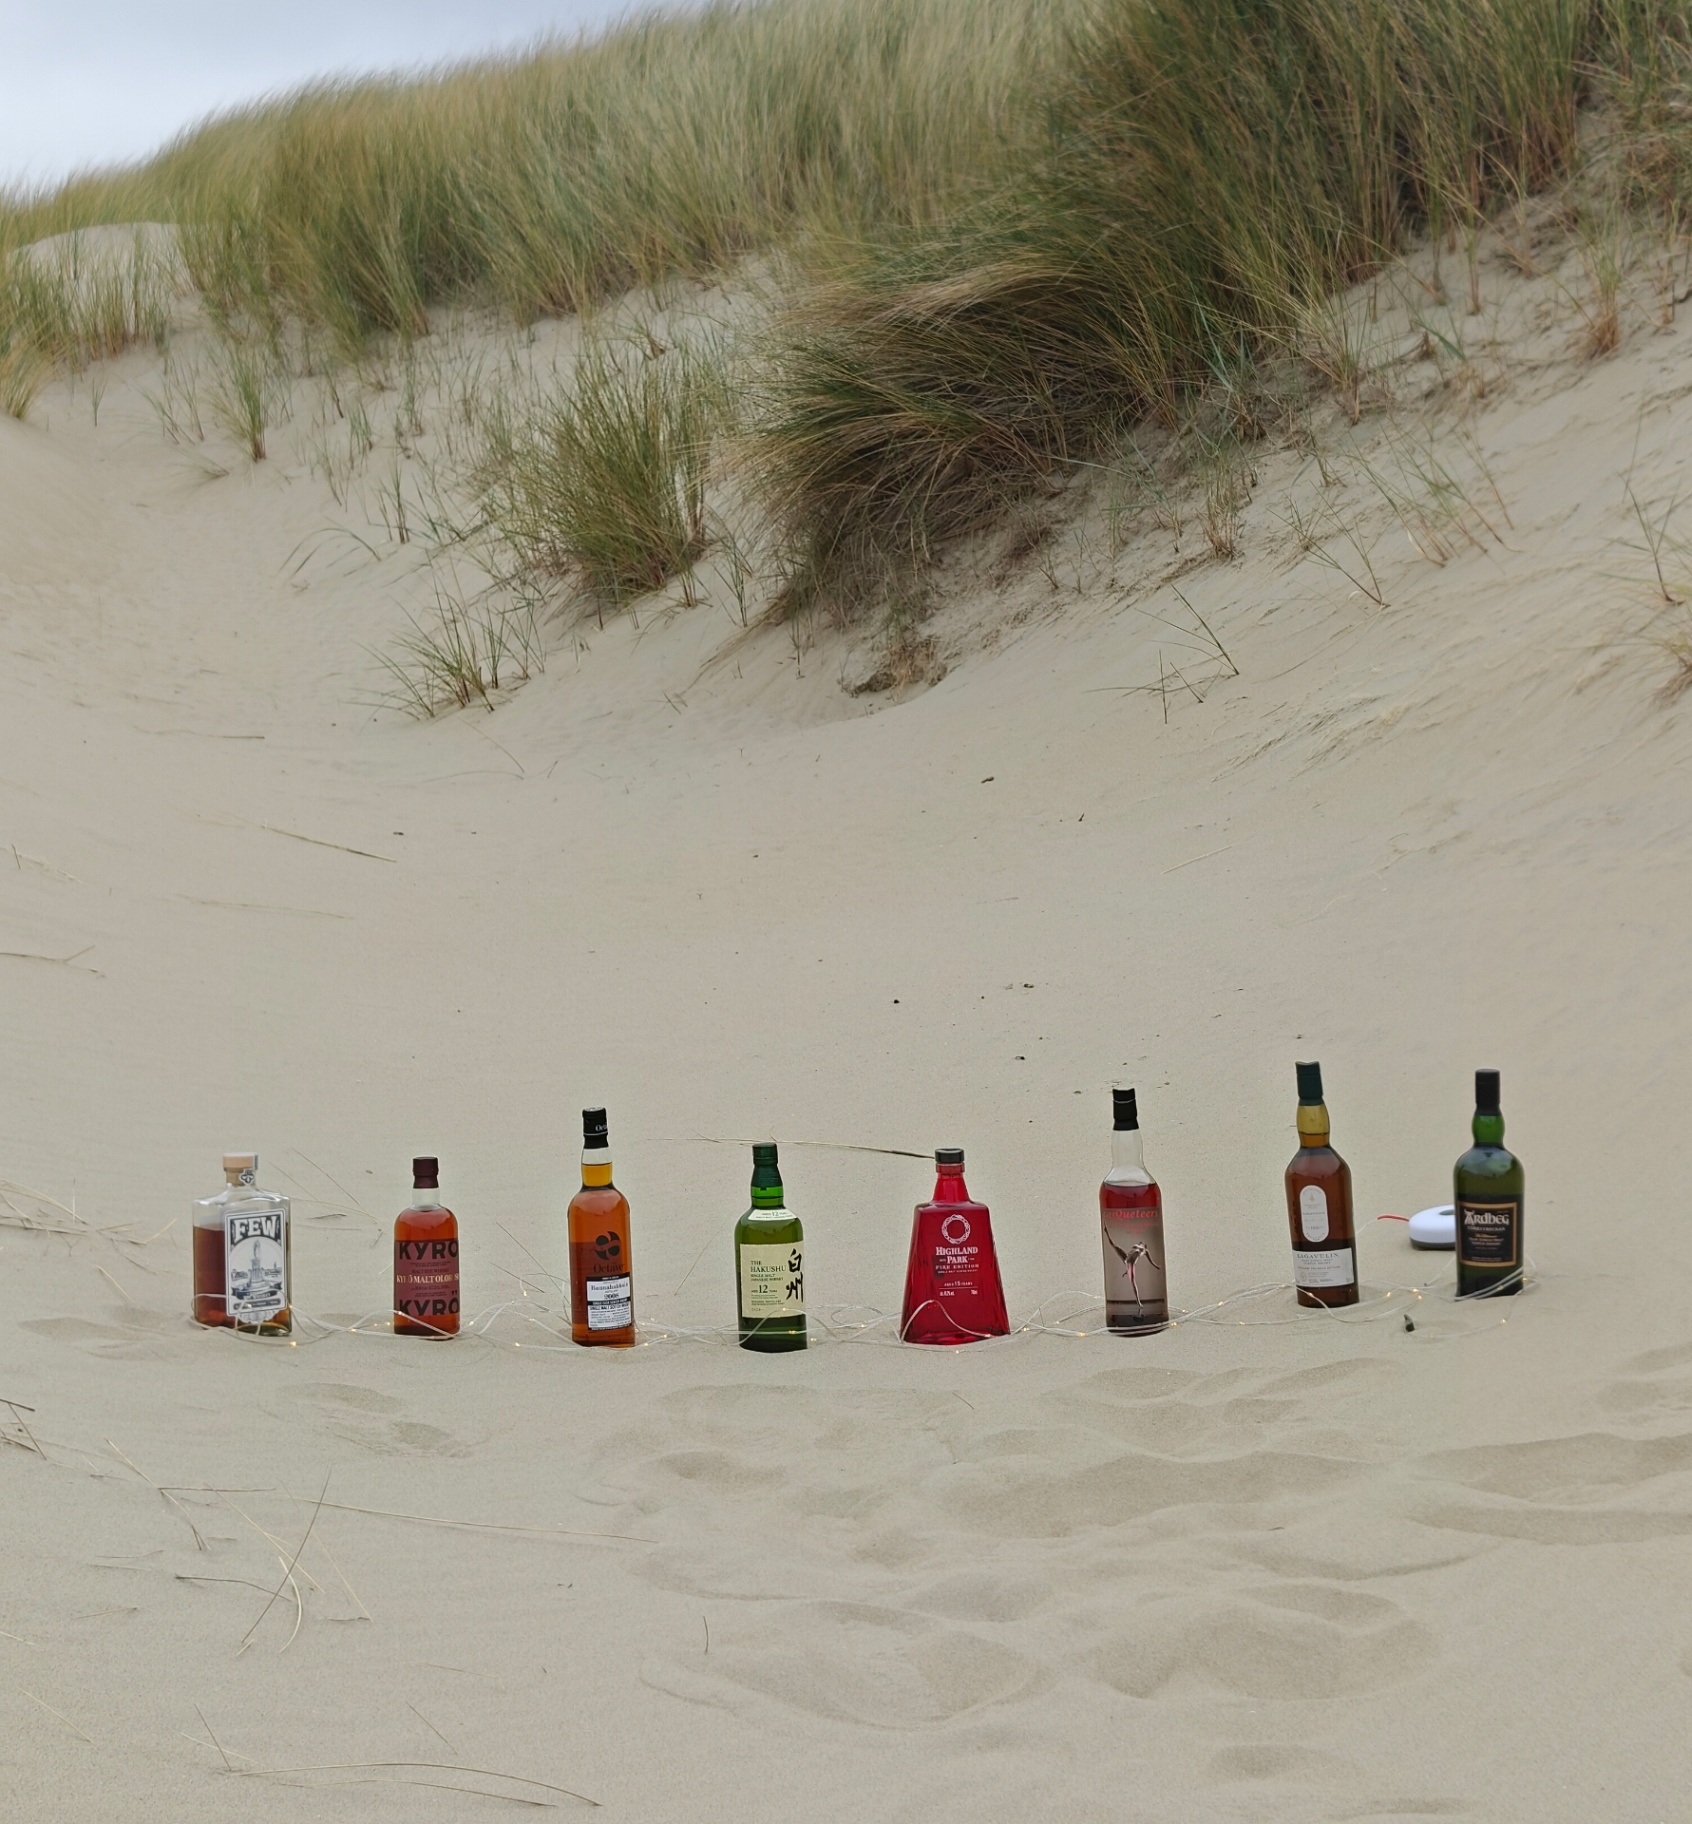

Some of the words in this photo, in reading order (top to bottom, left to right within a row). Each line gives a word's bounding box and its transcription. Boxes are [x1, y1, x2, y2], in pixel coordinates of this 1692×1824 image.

[234, 1215, 278, 1243] FEW
[936, 1246, 979, 1256] HIGHLAND
[947, 1255, 969, 1264] PARK
[750, 1265, 787, 1273] HAKUSHU
[413, 1275, 435, 1284] MALT
[785, 1248, 804, 1304] 白州
[759, 1284, 768, 1293] 12
